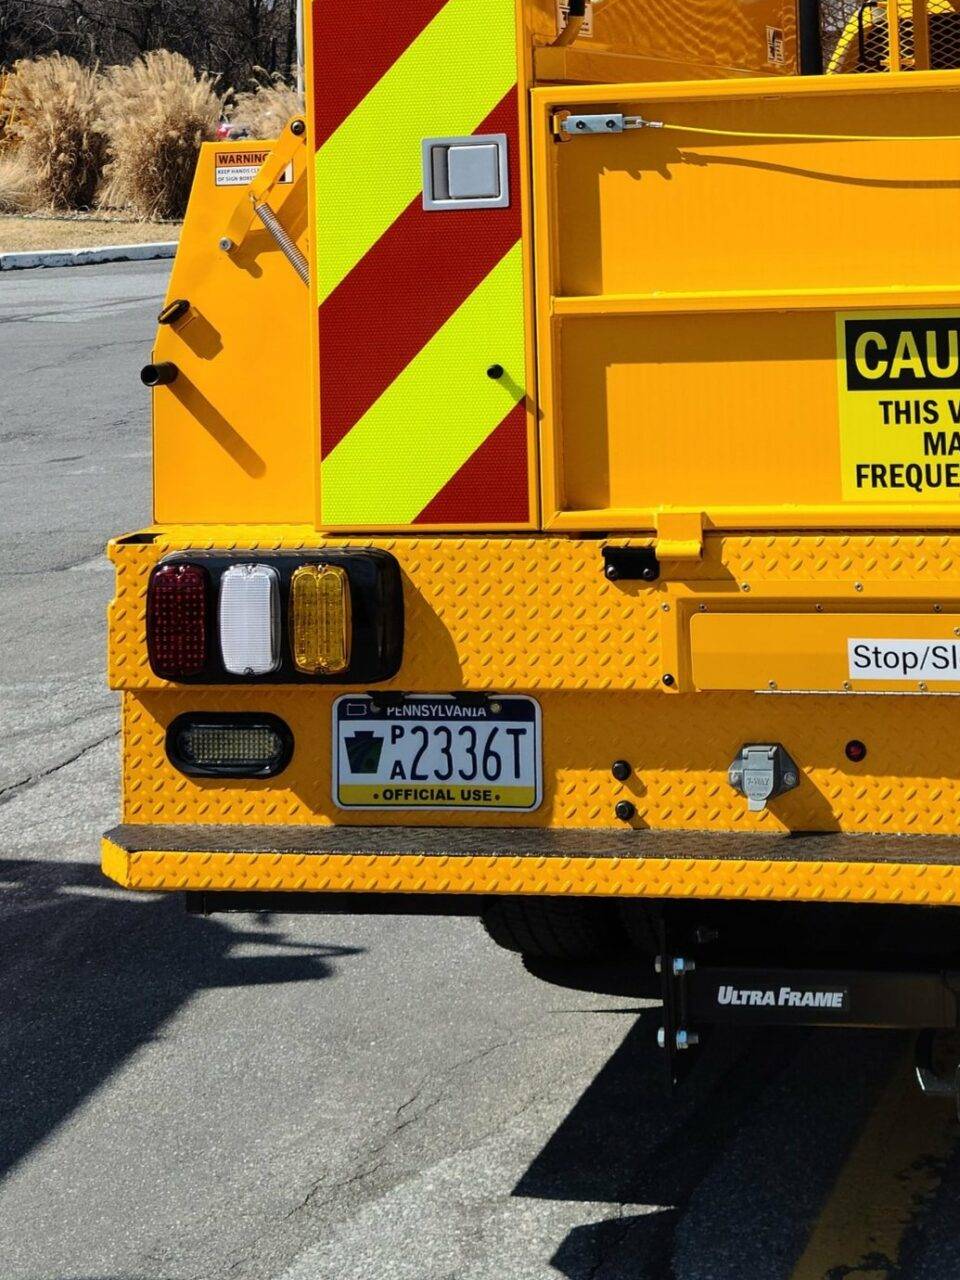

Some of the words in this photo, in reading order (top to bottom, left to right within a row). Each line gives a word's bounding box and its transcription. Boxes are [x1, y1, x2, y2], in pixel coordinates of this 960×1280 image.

[878, 399, 939, 425] THIS
[386, 704, 487, 717] PENNSYLVANIA
[382, 788, 455, 801] OFFICIAL
[460, 789, 492, 802] USE
[717, 985, 775, 1005] ULTRA
[777, 987, 843, 1007] FRAME
